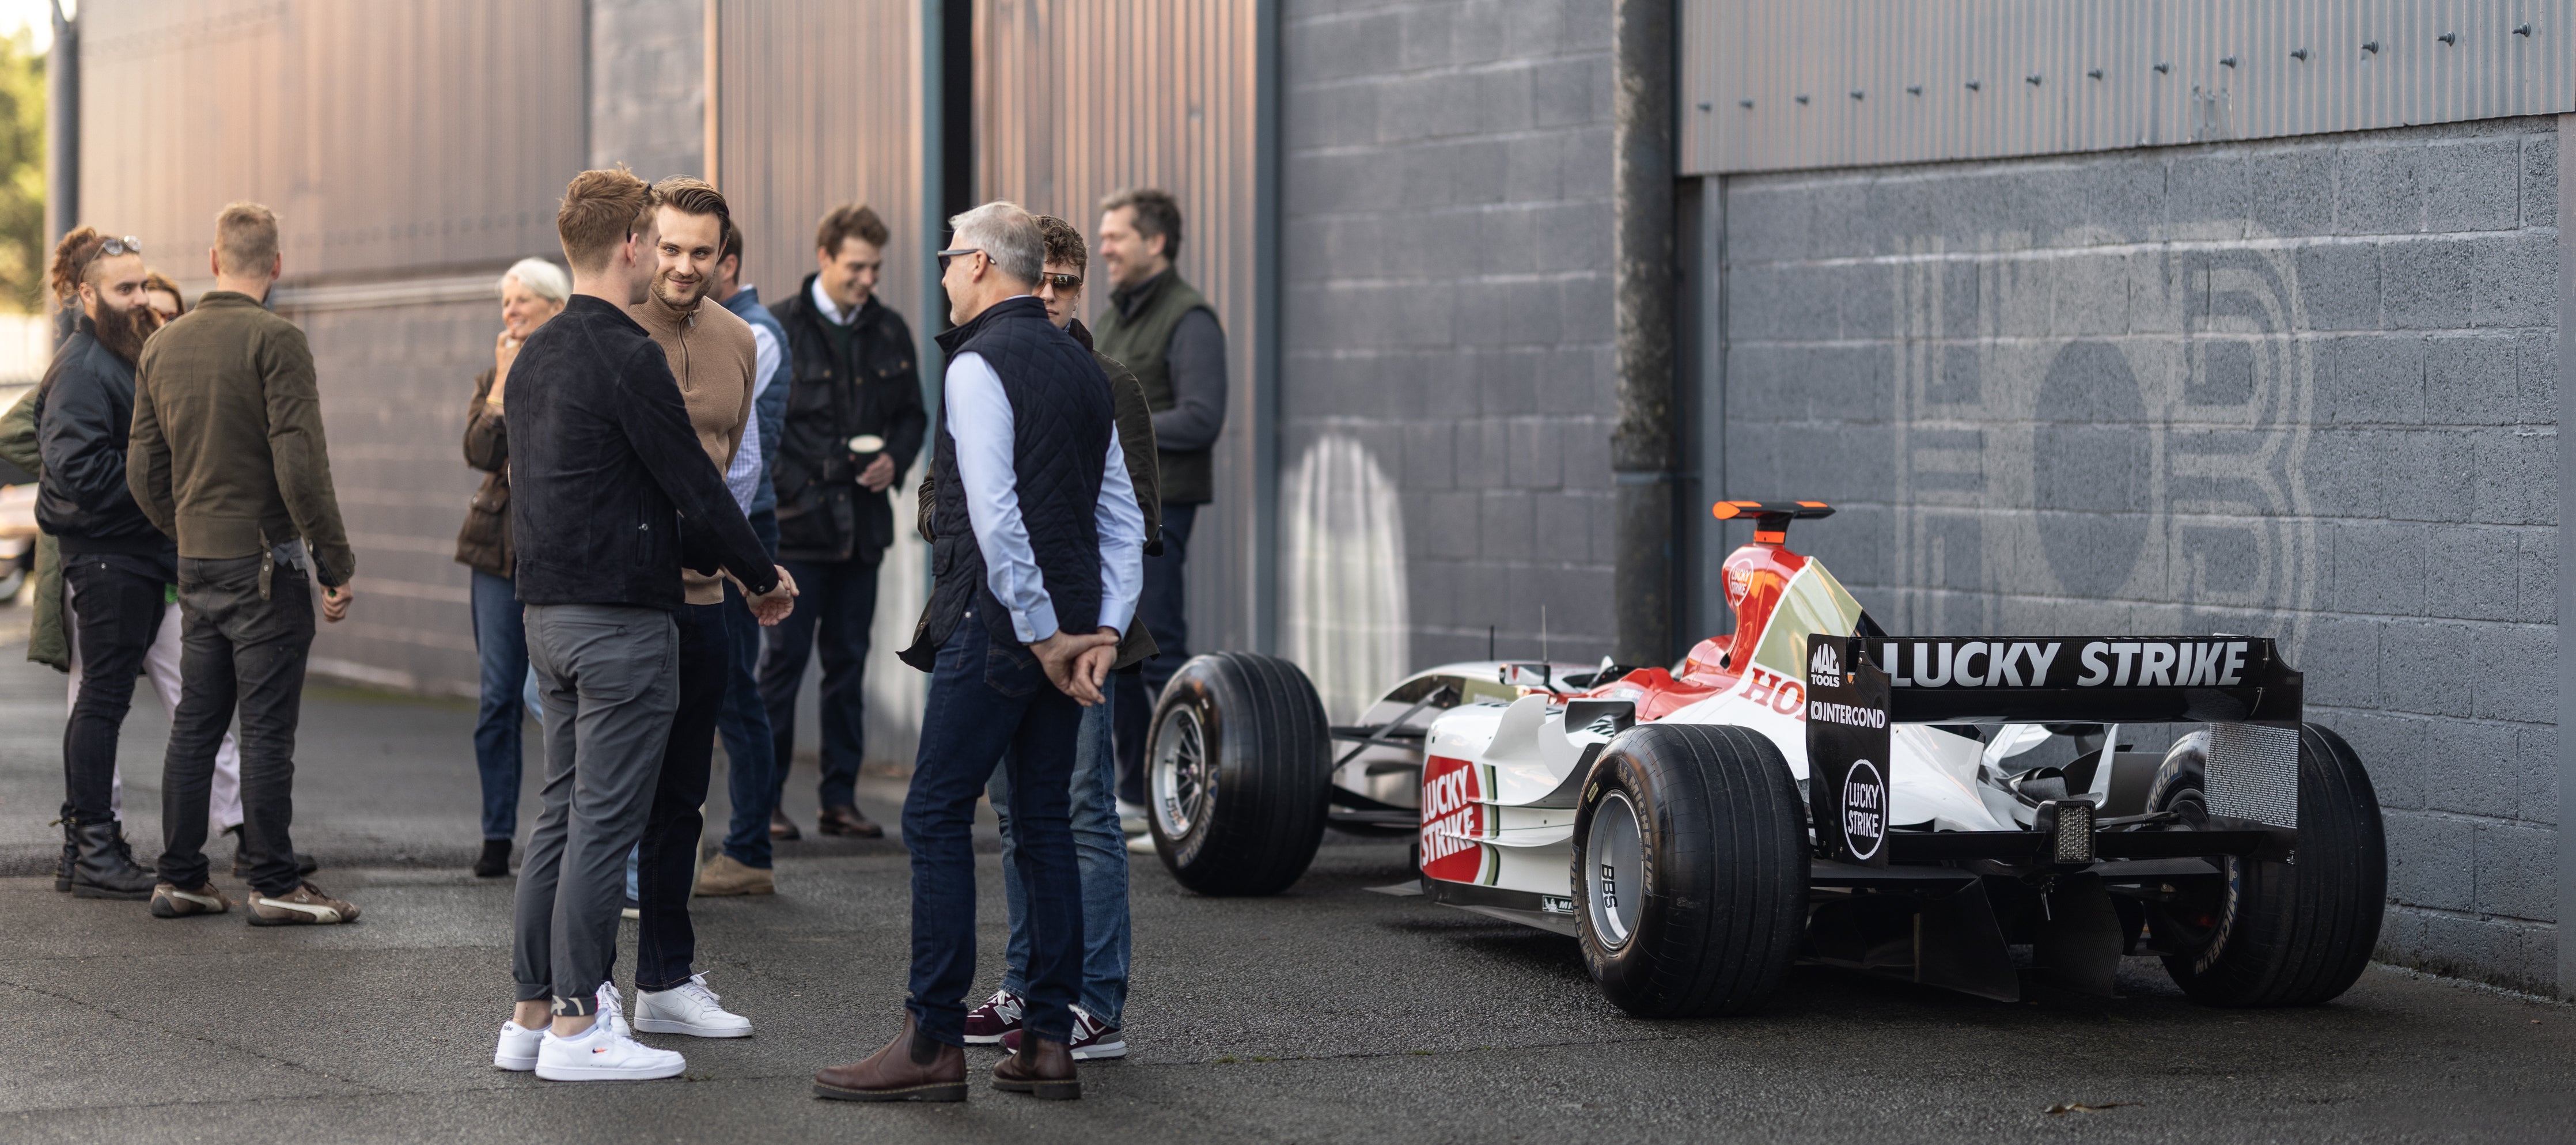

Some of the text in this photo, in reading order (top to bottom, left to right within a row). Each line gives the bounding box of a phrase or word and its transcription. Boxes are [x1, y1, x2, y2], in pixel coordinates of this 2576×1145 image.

[1731, 568, 1751, 582] LUCKY
[1731, 581, 1747, 596] STRIKE
[1811, 643, 1840, 675] MAC
[1883, 641, 2248, 688] LUCKY STRIKE
[1738, 667, 1806, 722] HO
[1811, 674, 1840, 688] TOOLS
[1823, 702, 1885, 729] INTERCOND
[1423, 764, 1469, 824] LUCKY
[1848, 782, 1880, 809] LUCKY
[2147, 759, 2180, 814] CHELIN
[1422, 806, 1476, 866] STRIKE
[1628, 775, 1653, 893] MICHELIN
[1848, 810, 1879, 838] STRIKE
[1559, 901, 1573, 909] MI
[1571, 848, 1593, 962] MICHELIN
[1601, 864, 1617, 908] BBS
[2195, 886, 2237, 975] MICHELIN
[993, 999, 1022, 1025] N
